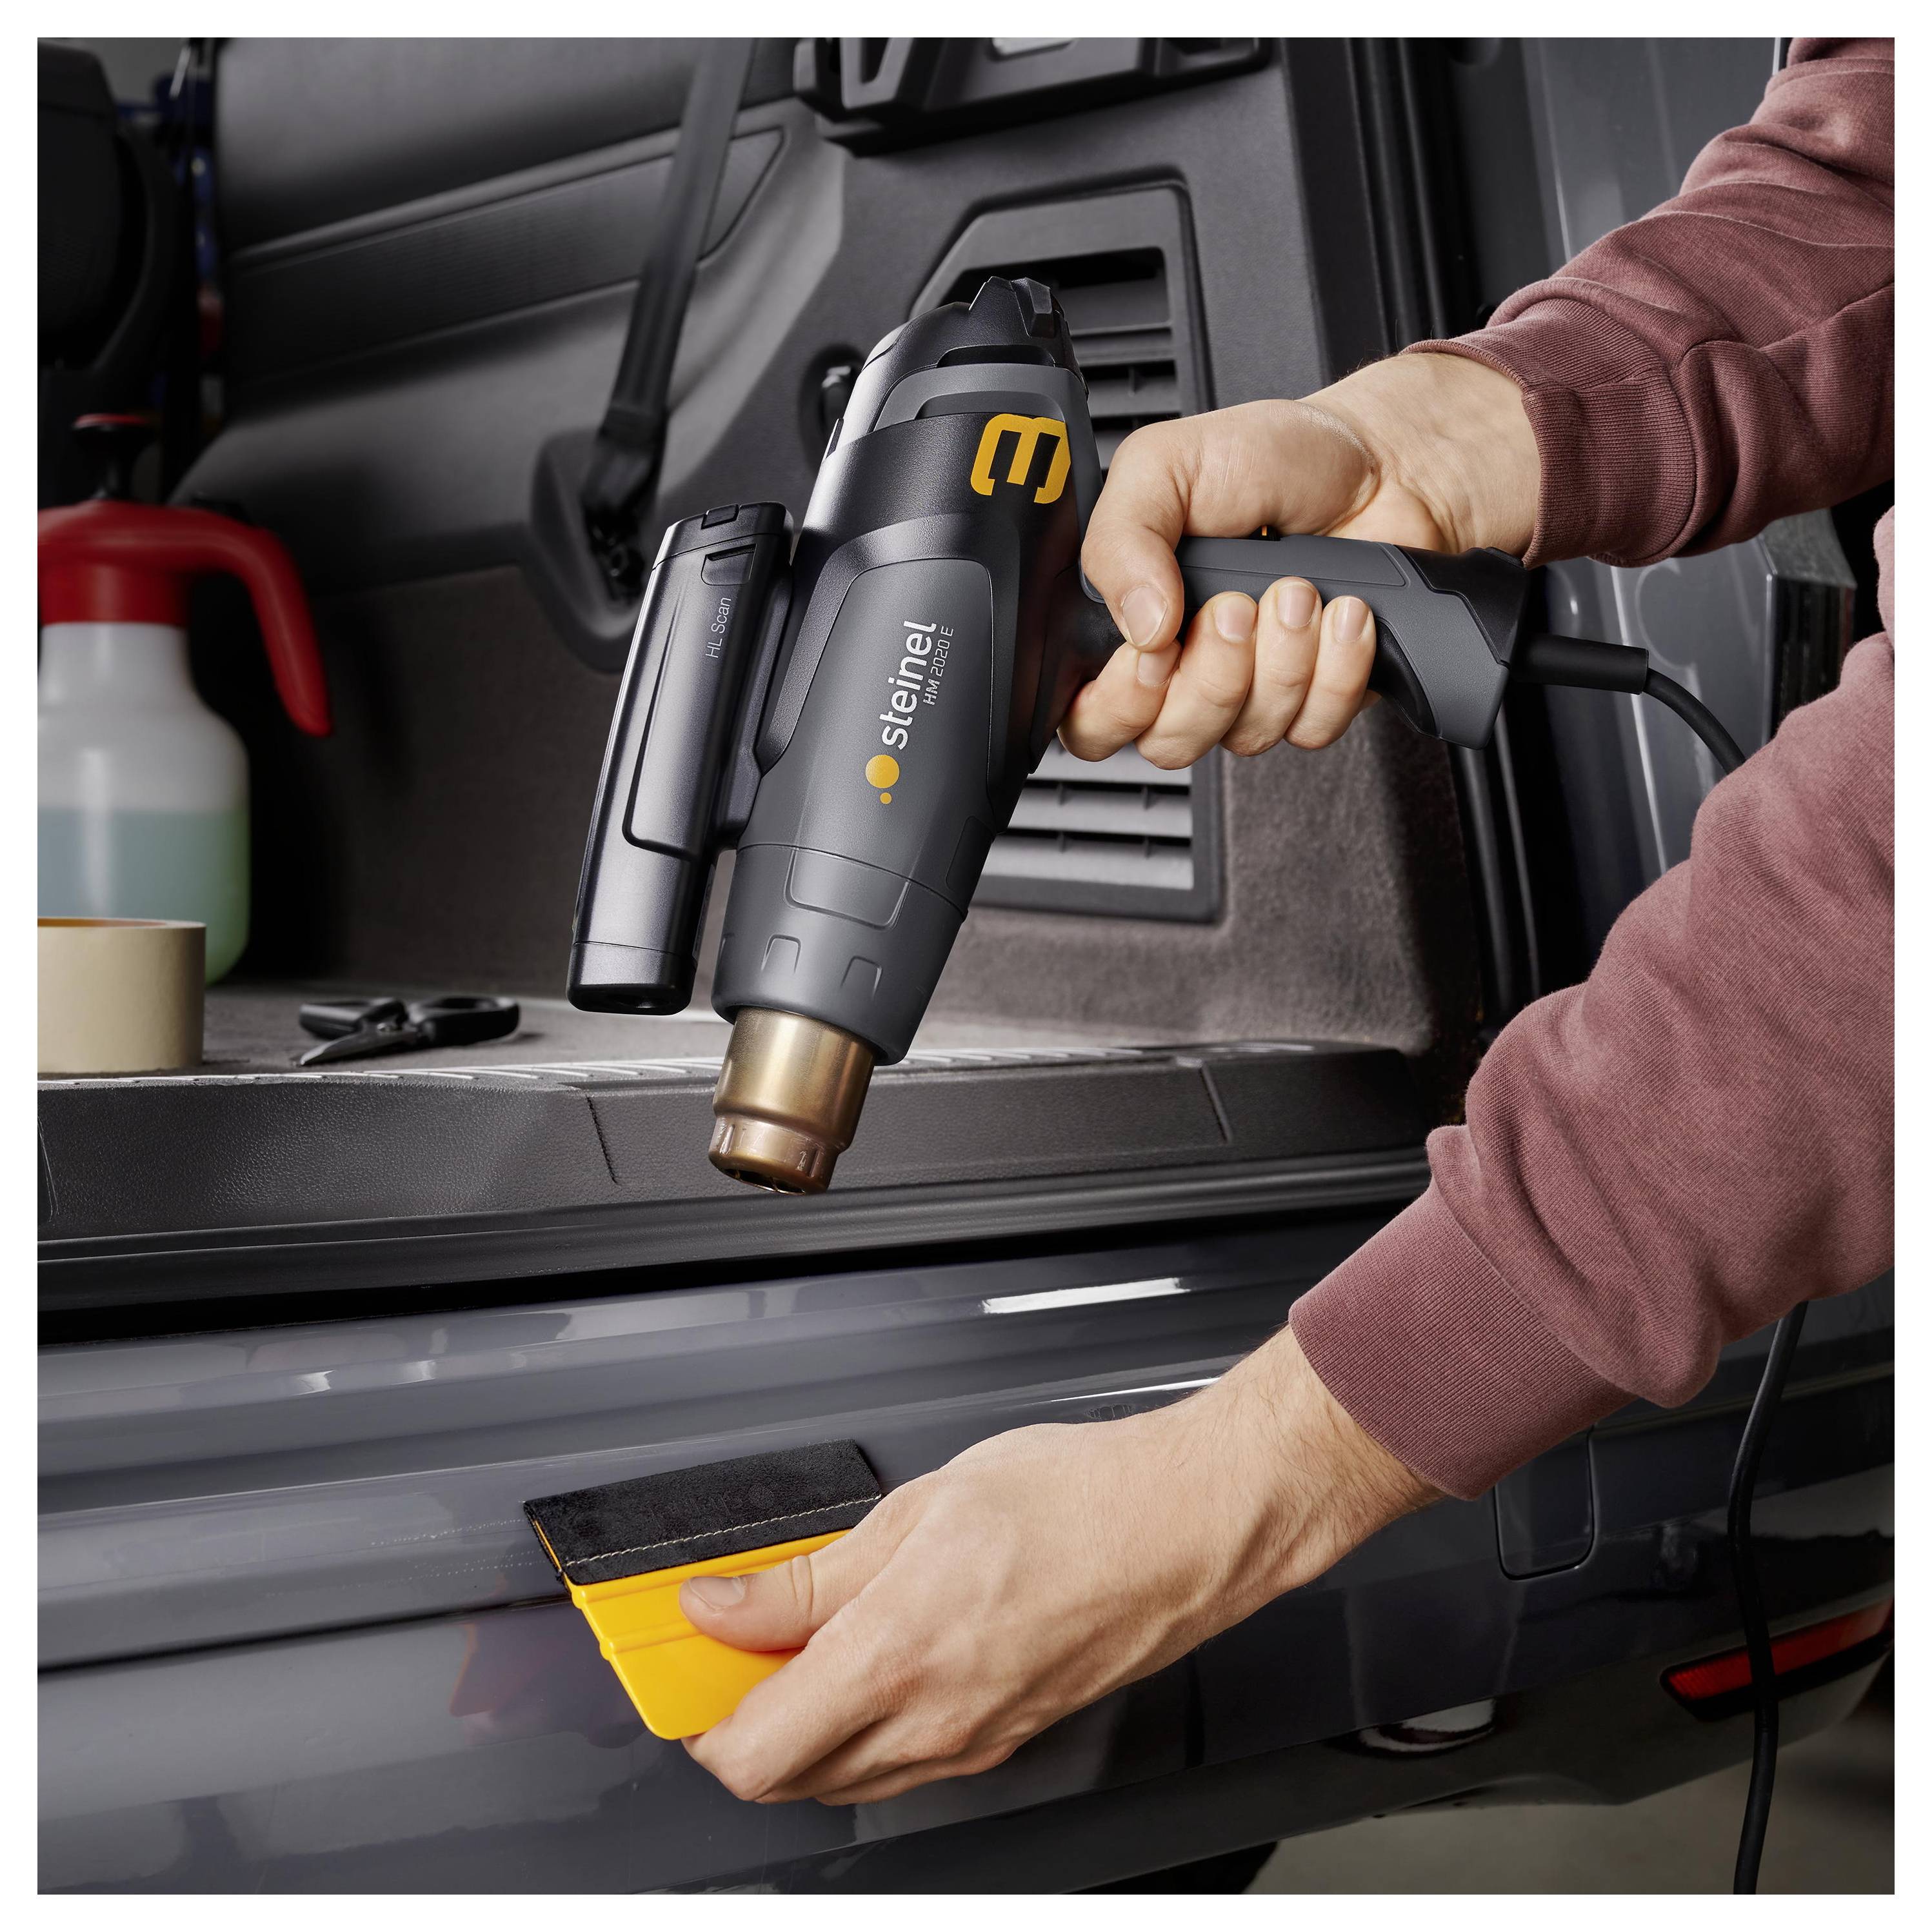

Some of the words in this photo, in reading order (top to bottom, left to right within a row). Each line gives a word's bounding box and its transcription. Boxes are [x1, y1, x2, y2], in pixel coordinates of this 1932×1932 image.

[711, 597, 732, 633] Scan
[941, 626, 953, 637] E
[705, 638, 722, 658] HL
[930, 639, 950, 677] 2020
[879, 621, 937, 750] steinel
[922, 679, 940, 705] HM
